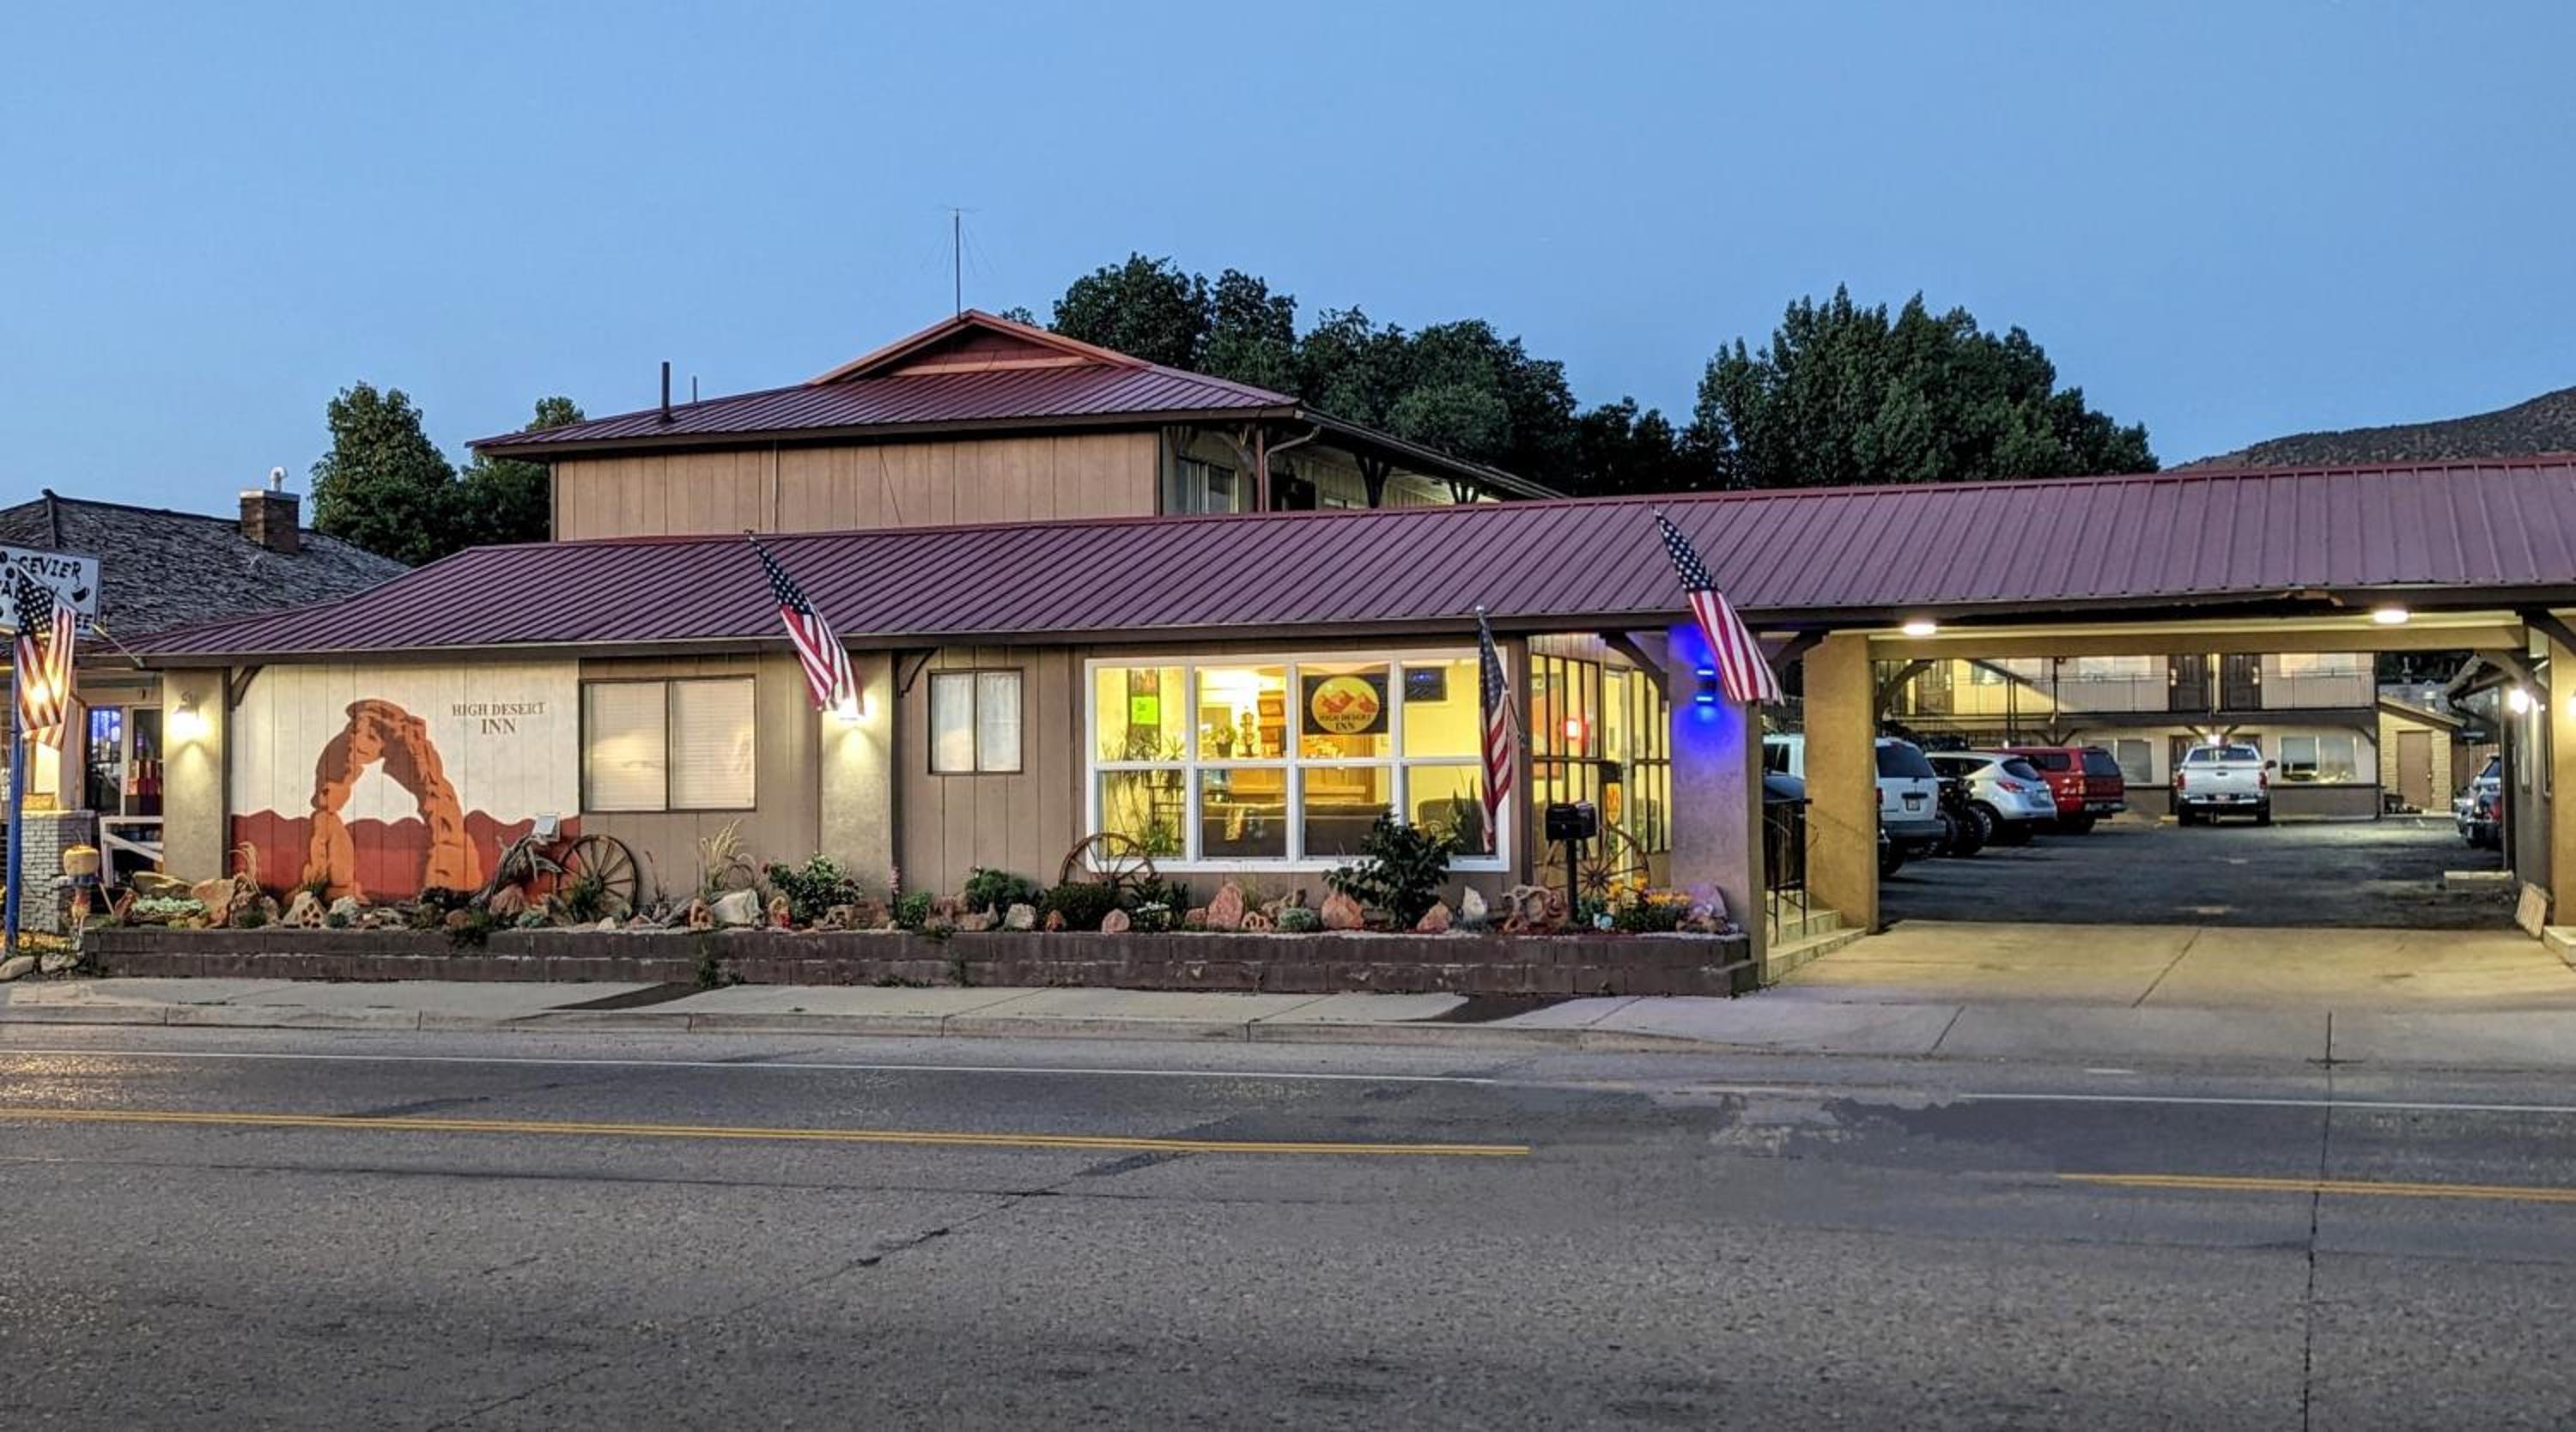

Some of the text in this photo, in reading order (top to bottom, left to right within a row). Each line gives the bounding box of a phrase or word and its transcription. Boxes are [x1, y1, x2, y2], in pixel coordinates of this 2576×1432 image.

[453, 701, 546, 716] HIGH DESERT
[482, 718, 515, 735] INN
